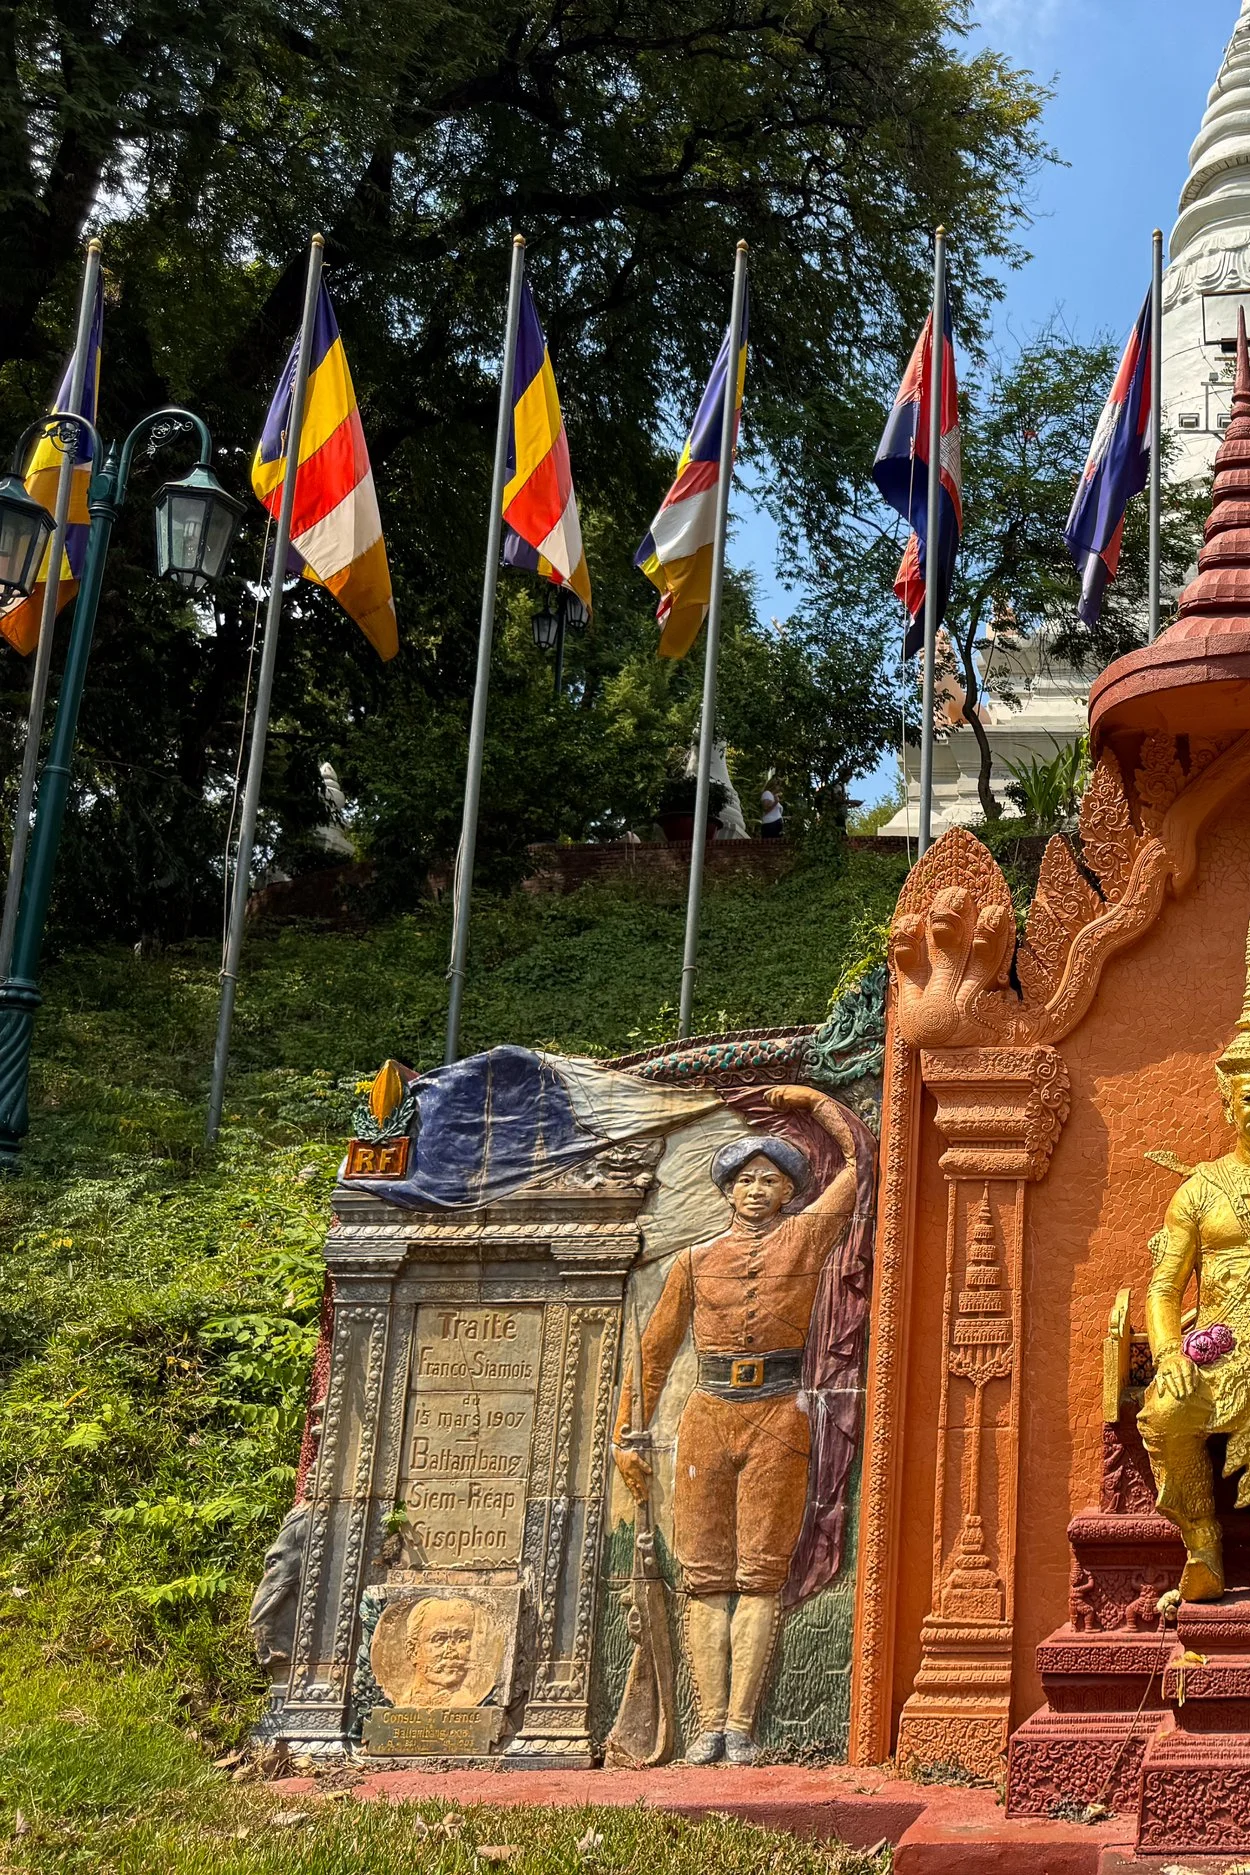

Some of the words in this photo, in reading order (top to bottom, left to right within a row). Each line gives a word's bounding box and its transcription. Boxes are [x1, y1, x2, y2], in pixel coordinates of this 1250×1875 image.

[356, 1148, 397, 1172] RF
[437, 1311, 521, 1341] Traité
[418, 1346, 533, 1379] Franco-Siamois
[462, 1394, 480, 1406] du
[415, 1409, 431, 1427] 15
[438, 1411, 480, 1430] mars
[487, 1411, 526, 1429] 1907
[409, 1436, 523, 1476] Battambang
[407, 1482, 516, 1519] Siem-Réap
[409, 1521, 507, 1557] Sisophon
